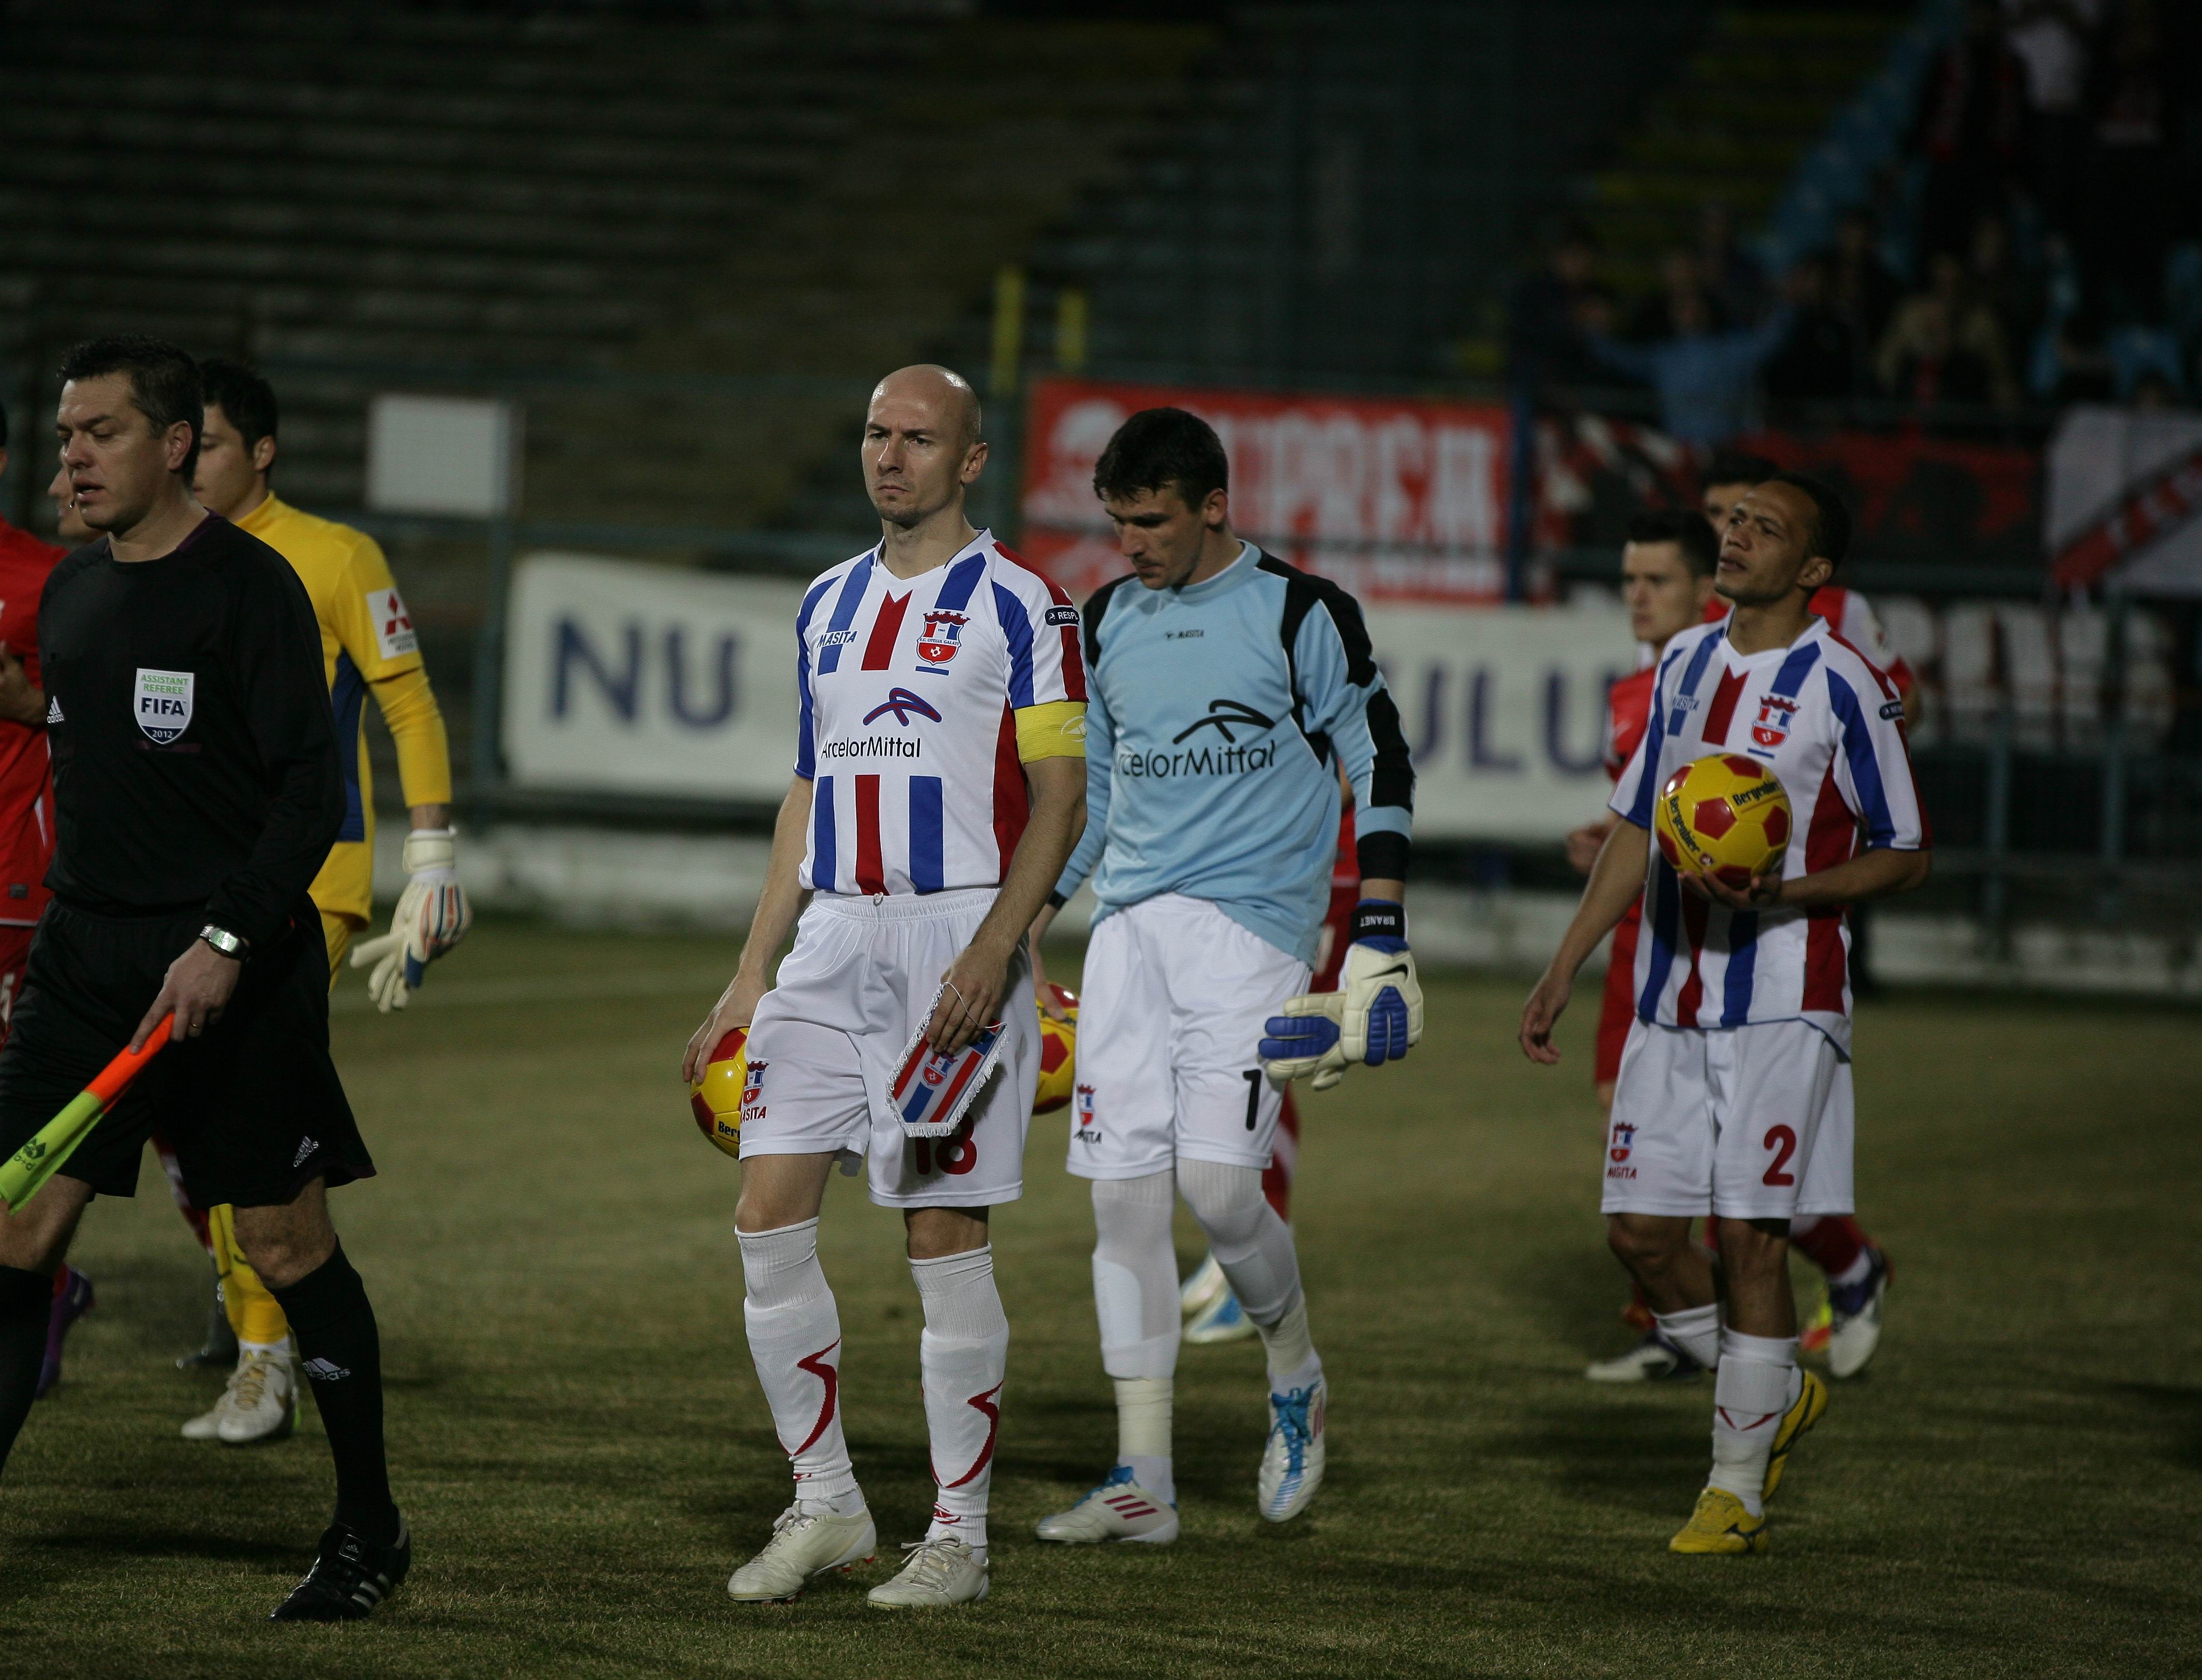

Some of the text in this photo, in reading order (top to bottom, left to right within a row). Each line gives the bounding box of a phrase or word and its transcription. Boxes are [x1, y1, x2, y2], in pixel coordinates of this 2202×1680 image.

[817, 630, 858, 648] MASITA
[140, 674, 189, 685] ASSISTANT
[552, 615, 738, 726] NU
[143, 683, 184, 694] REFEREE
[141, 697, 185, 716] FIFA
[152, 729, 174, 738] 2012
[821, 736, 921, 759] ArcelorMittal
[1243, 1069, 1261, 1131] 1
[915, 1113, 977, 1175] 18
[1763, 1124, 1796, 1186] 2
